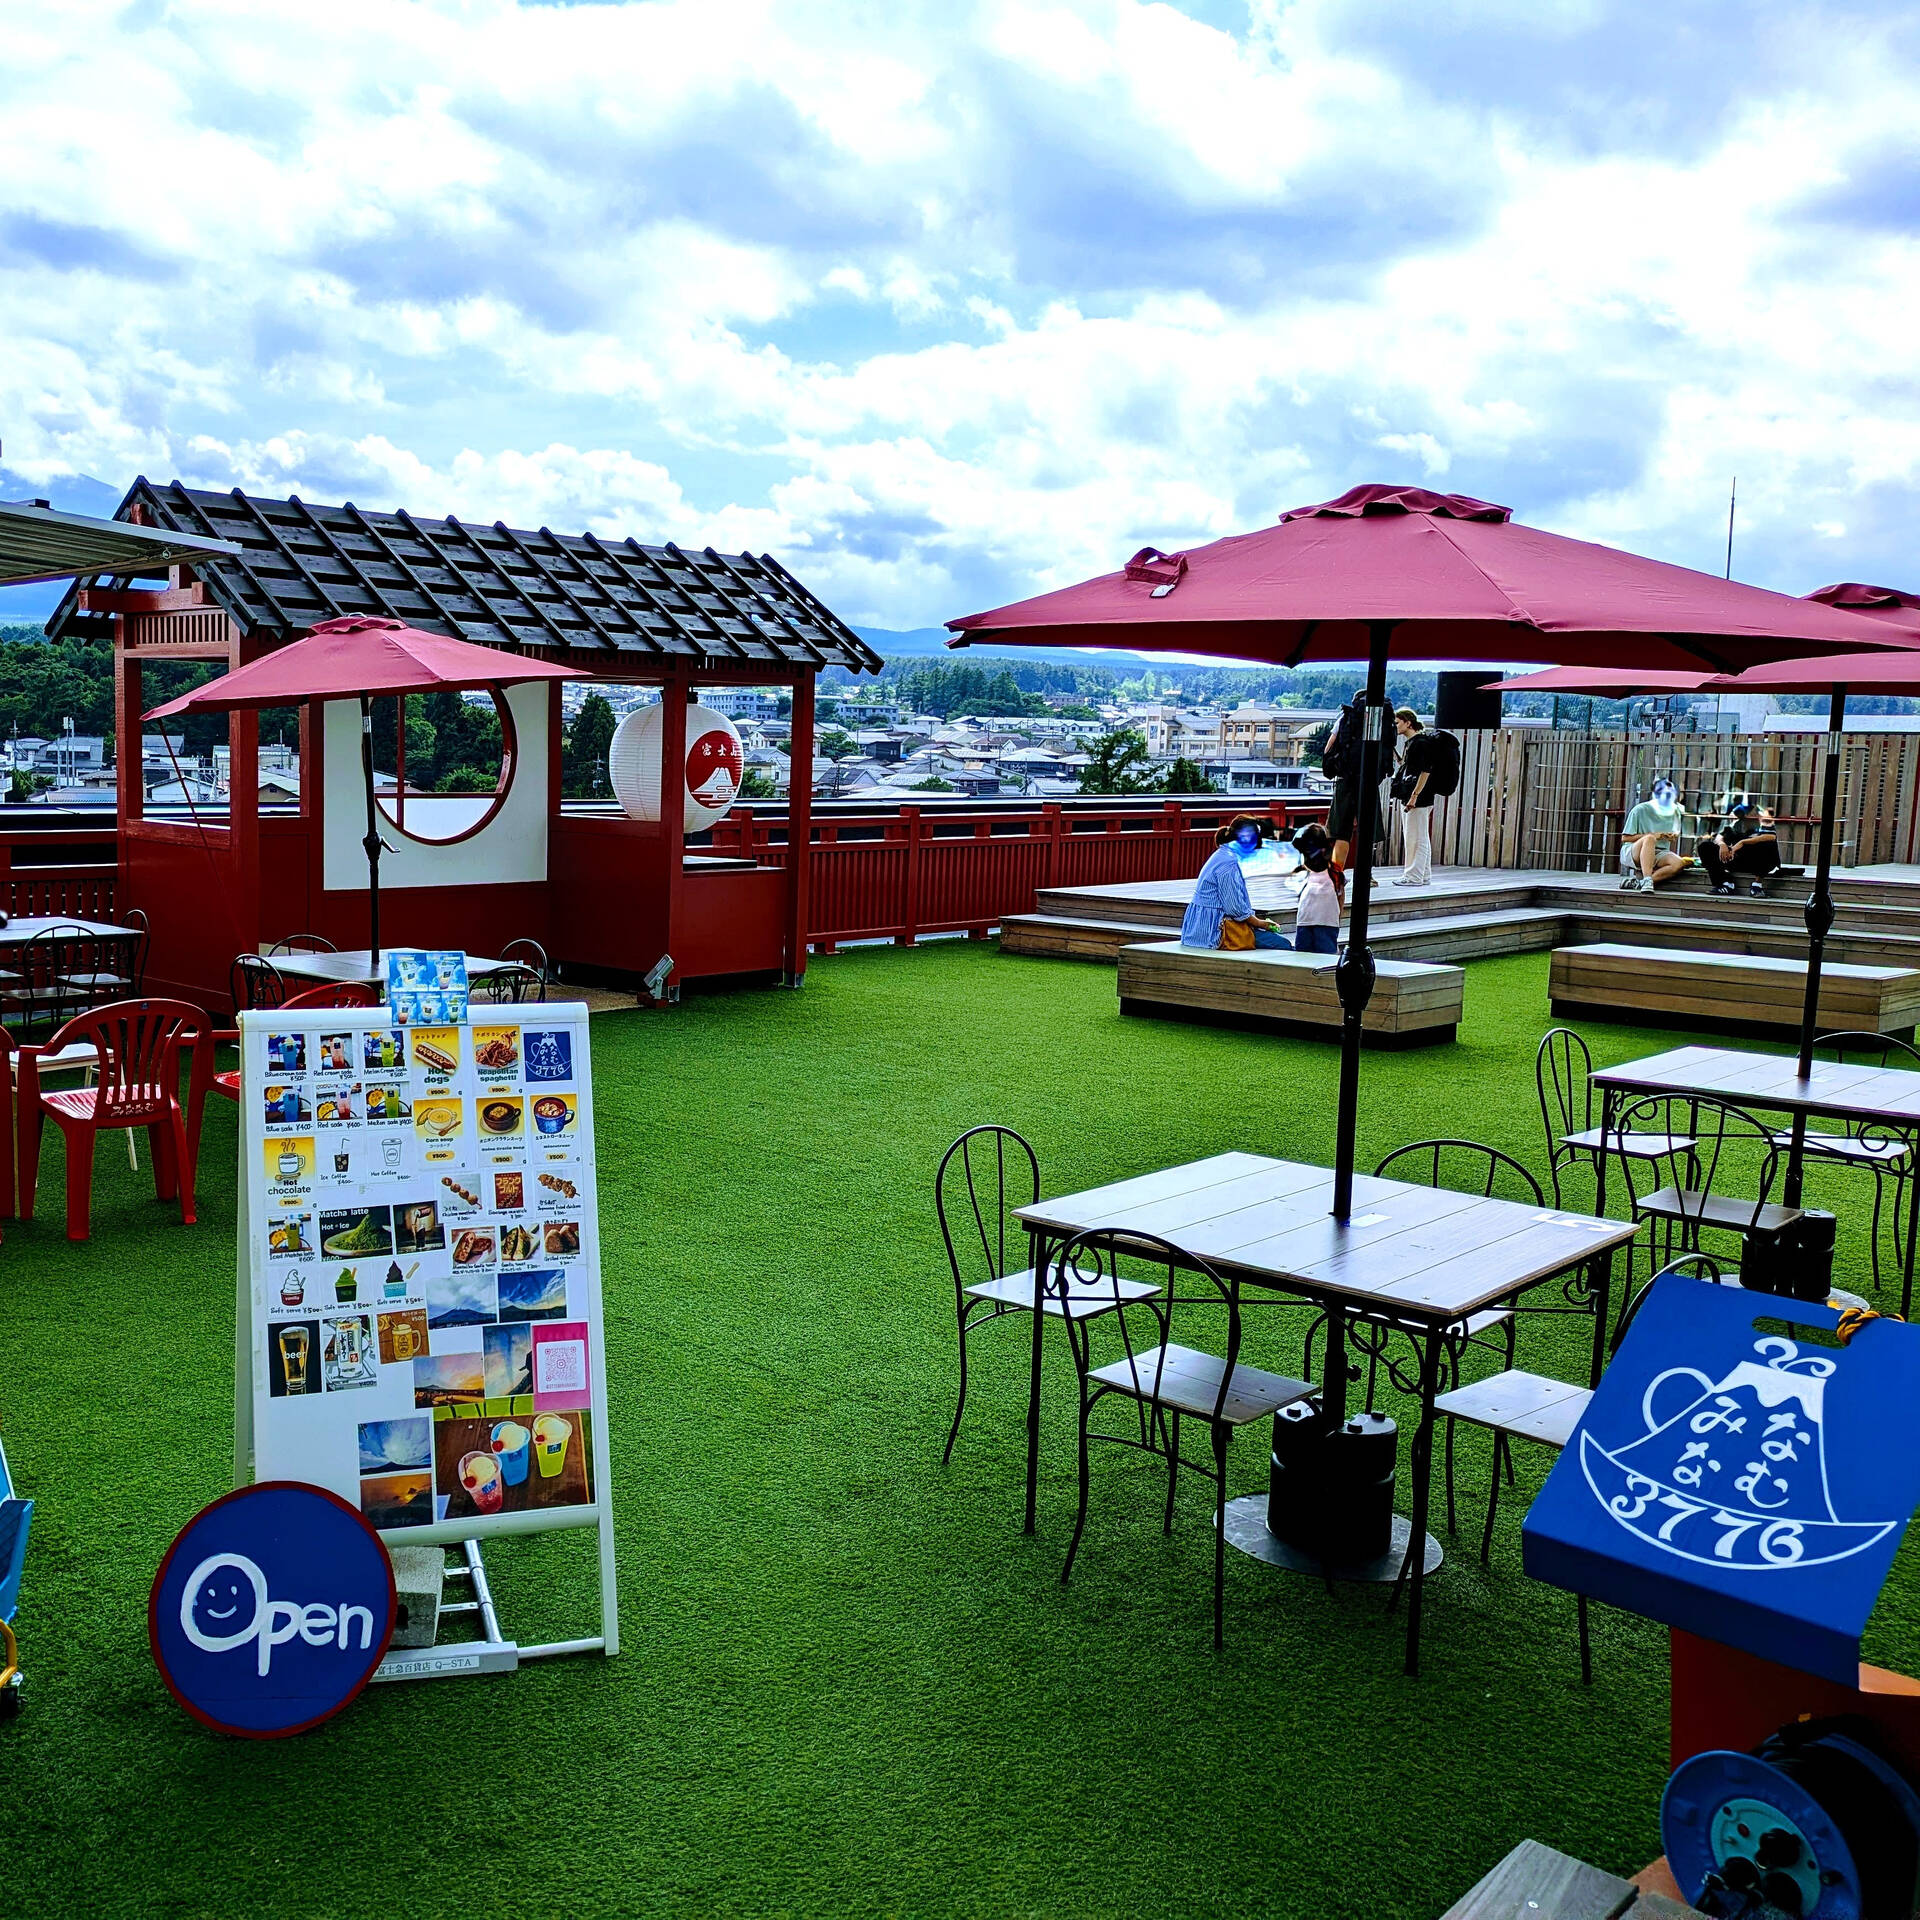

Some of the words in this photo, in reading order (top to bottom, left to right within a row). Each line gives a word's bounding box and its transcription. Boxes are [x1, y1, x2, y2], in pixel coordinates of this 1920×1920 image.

[478, 1068, 518, 1077] Neapolitan
[535, 1064, 565, 1076] 3776
[424, 1076, 450, 1084] dogs
[480, 1075, 517, 1083] spaghetti
[268, 1186, 311, 1195] chocolate
[319, 1209, 347, 1218] Matcha
[284, 1351, 306, 1359] beer
[1610, 1472, 1805, 1565] 3776
[180, 1552, 374, 1677] Open
[378, 1662, 431, 1676] 富士急百貨店
